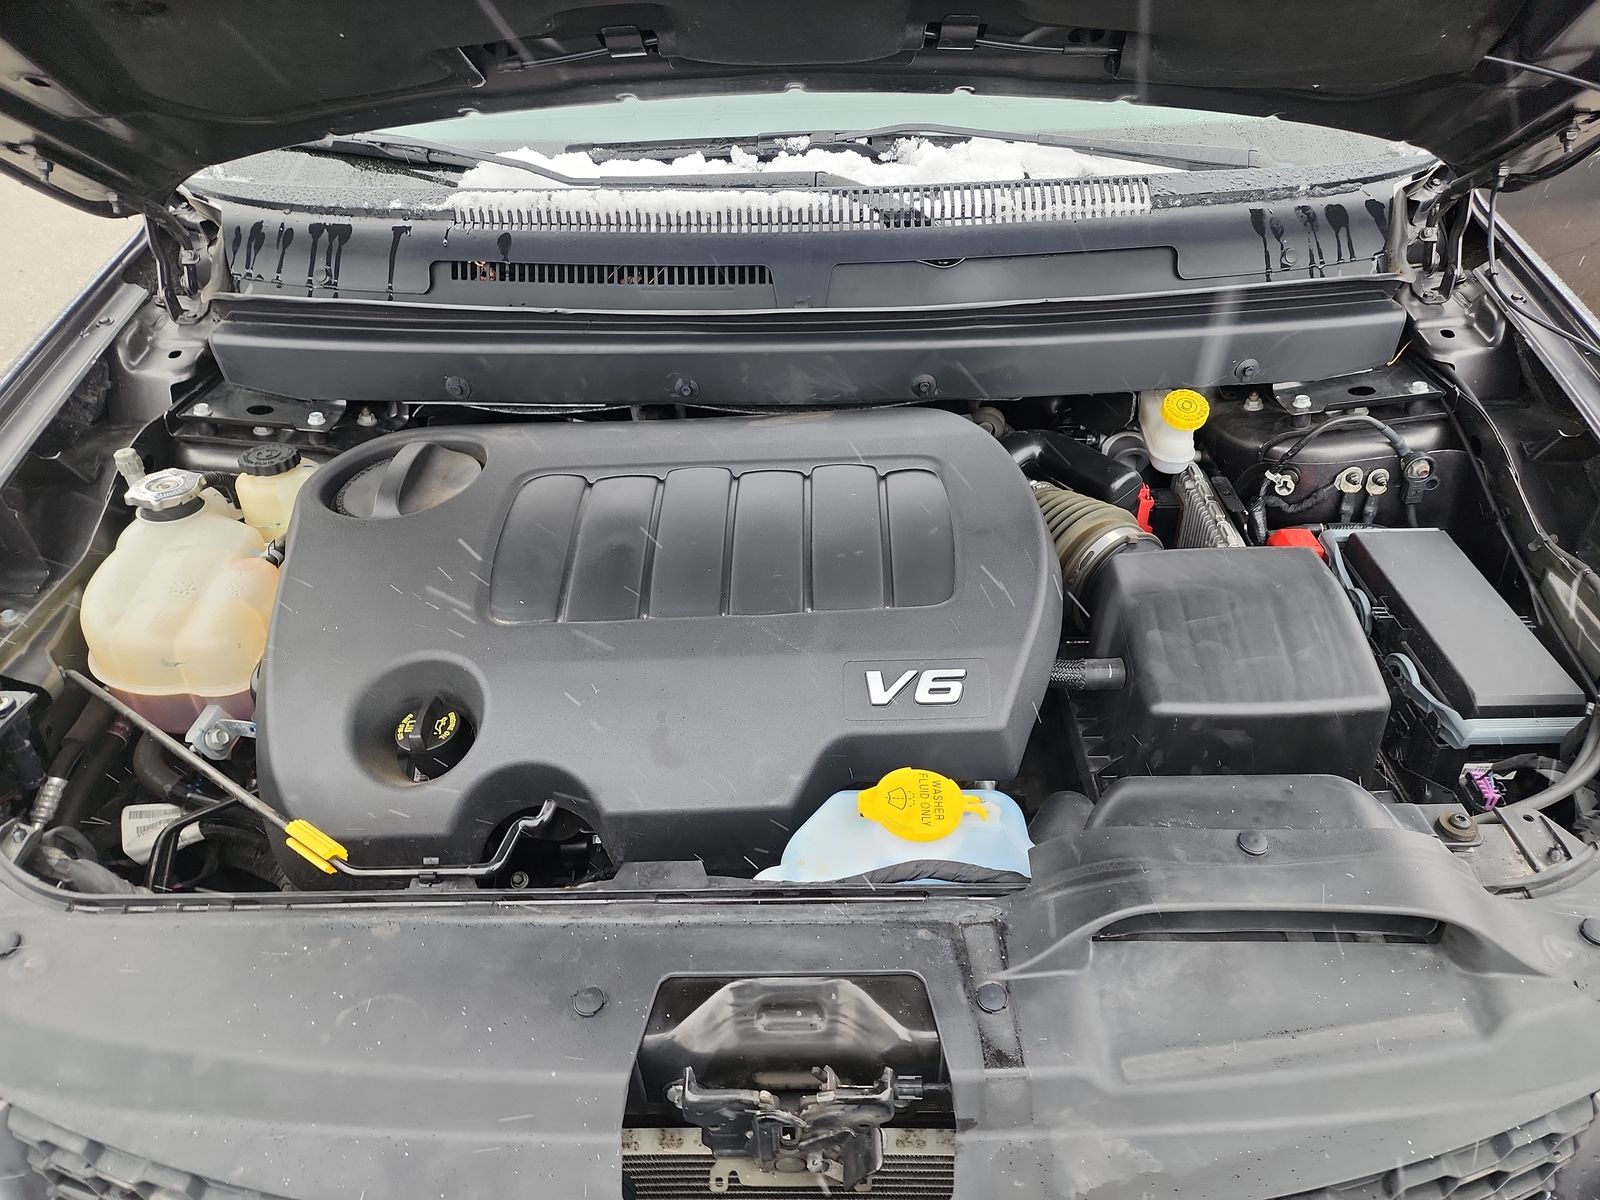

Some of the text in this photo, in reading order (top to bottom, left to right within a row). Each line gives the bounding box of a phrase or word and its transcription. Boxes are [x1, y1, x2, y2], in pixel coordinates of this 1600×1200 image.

[864, 668, 967, 707] V6
[438, 730, 451, 740] OIL
[918, 772, 932, 827] FLUID ONLY
[932, 780, 945, 821] WASHER
